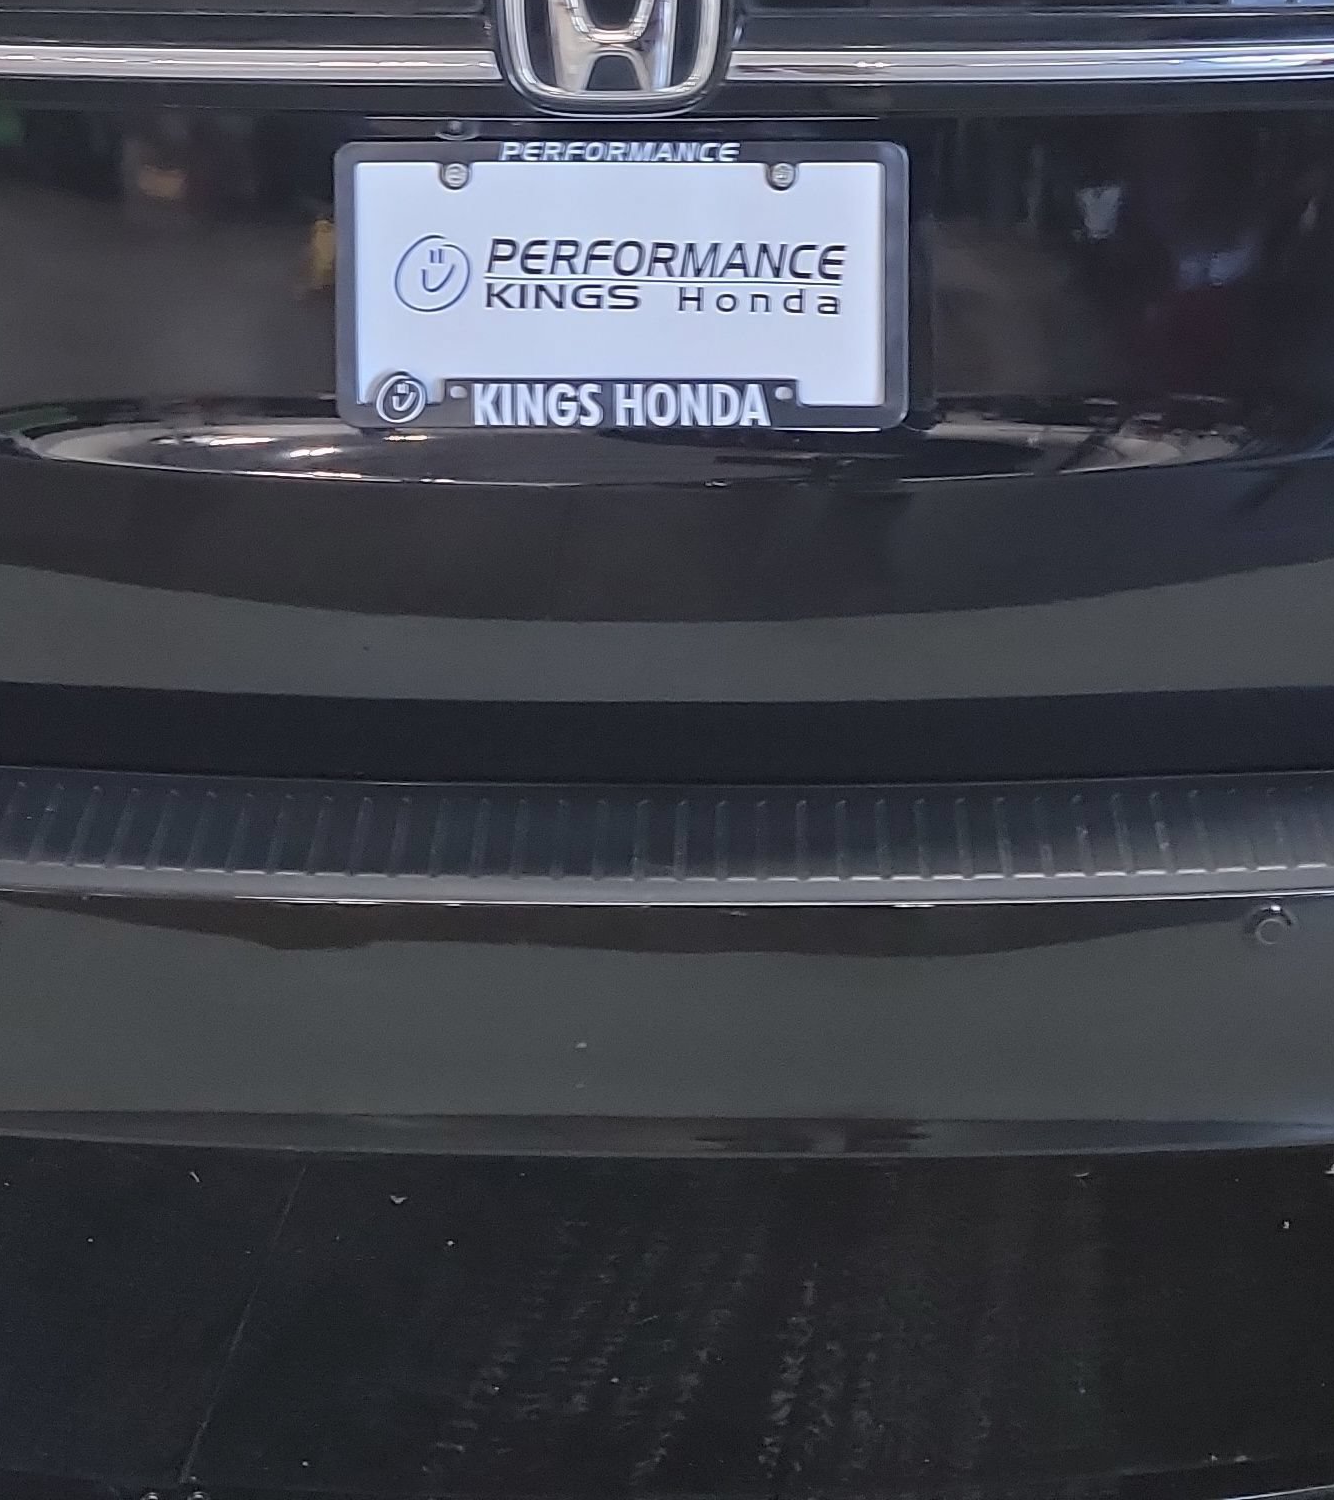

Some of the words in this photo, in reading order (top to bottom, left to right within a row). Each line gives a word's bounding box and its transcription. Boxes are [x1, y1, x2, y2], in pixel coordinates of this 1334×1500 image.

[499, 141, 740, 162] PERFORMANCE
[486, 238, 848, 280] PERFORMANCE
[485, 283, 641, 309] KINGS
[679, 287, 841, 315] Honda
[473, 383, 603, 426] KINGS
[615, 383, 771, 427] HONDA
